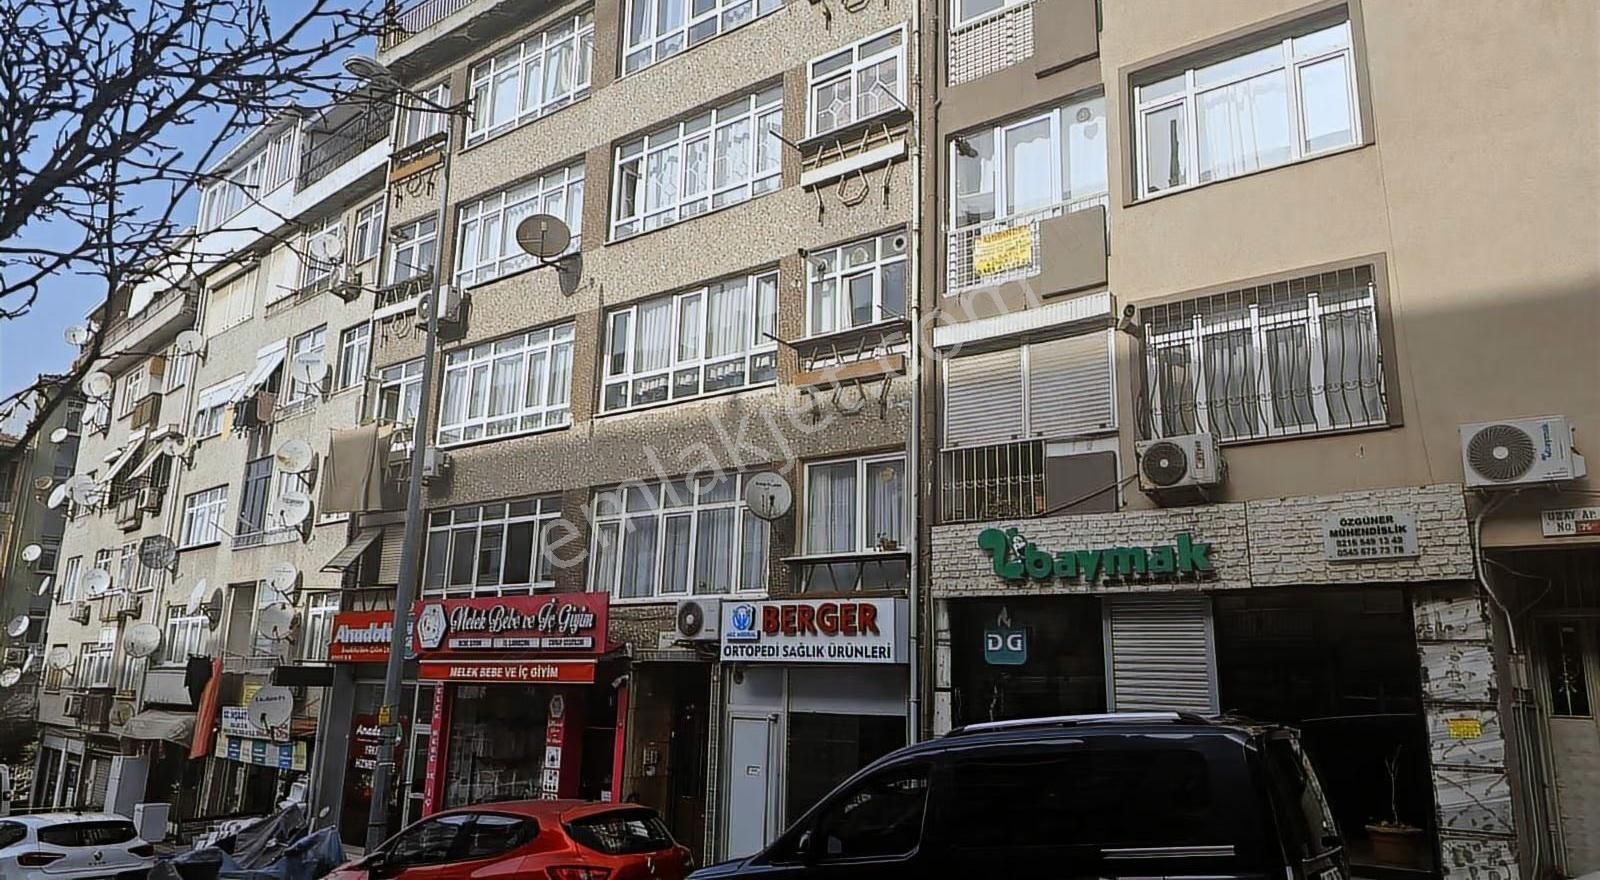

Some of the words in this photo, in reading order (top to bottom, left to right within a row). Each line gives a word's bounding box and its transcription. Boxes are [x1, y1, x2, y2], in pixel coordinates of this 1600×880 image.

[1329, 524, 1407, 537] MÜHENDİSLİK
[1025, 533, 1212, 582] baymak
[450, 606, 486, 633] Melek
[488, 605, 521, 632] Bebe
[558, 603, 594, 634] Giyim
[762, 602, 879, 637] BERGER
[723, 641, 780, 658] ORTOPEDİ
[782, 641, 825, 658] SAĞLIK
[828, 642, 892, 659] ÜRÜNLERİ
[449, 667, 479, 678] MELEK
[480, 667, 503, 678] BEBE
[505, 666, 518, 677] VE
[519, 665, 529, 679] İÇ
[530, 664, 559, 678] GİYİM
